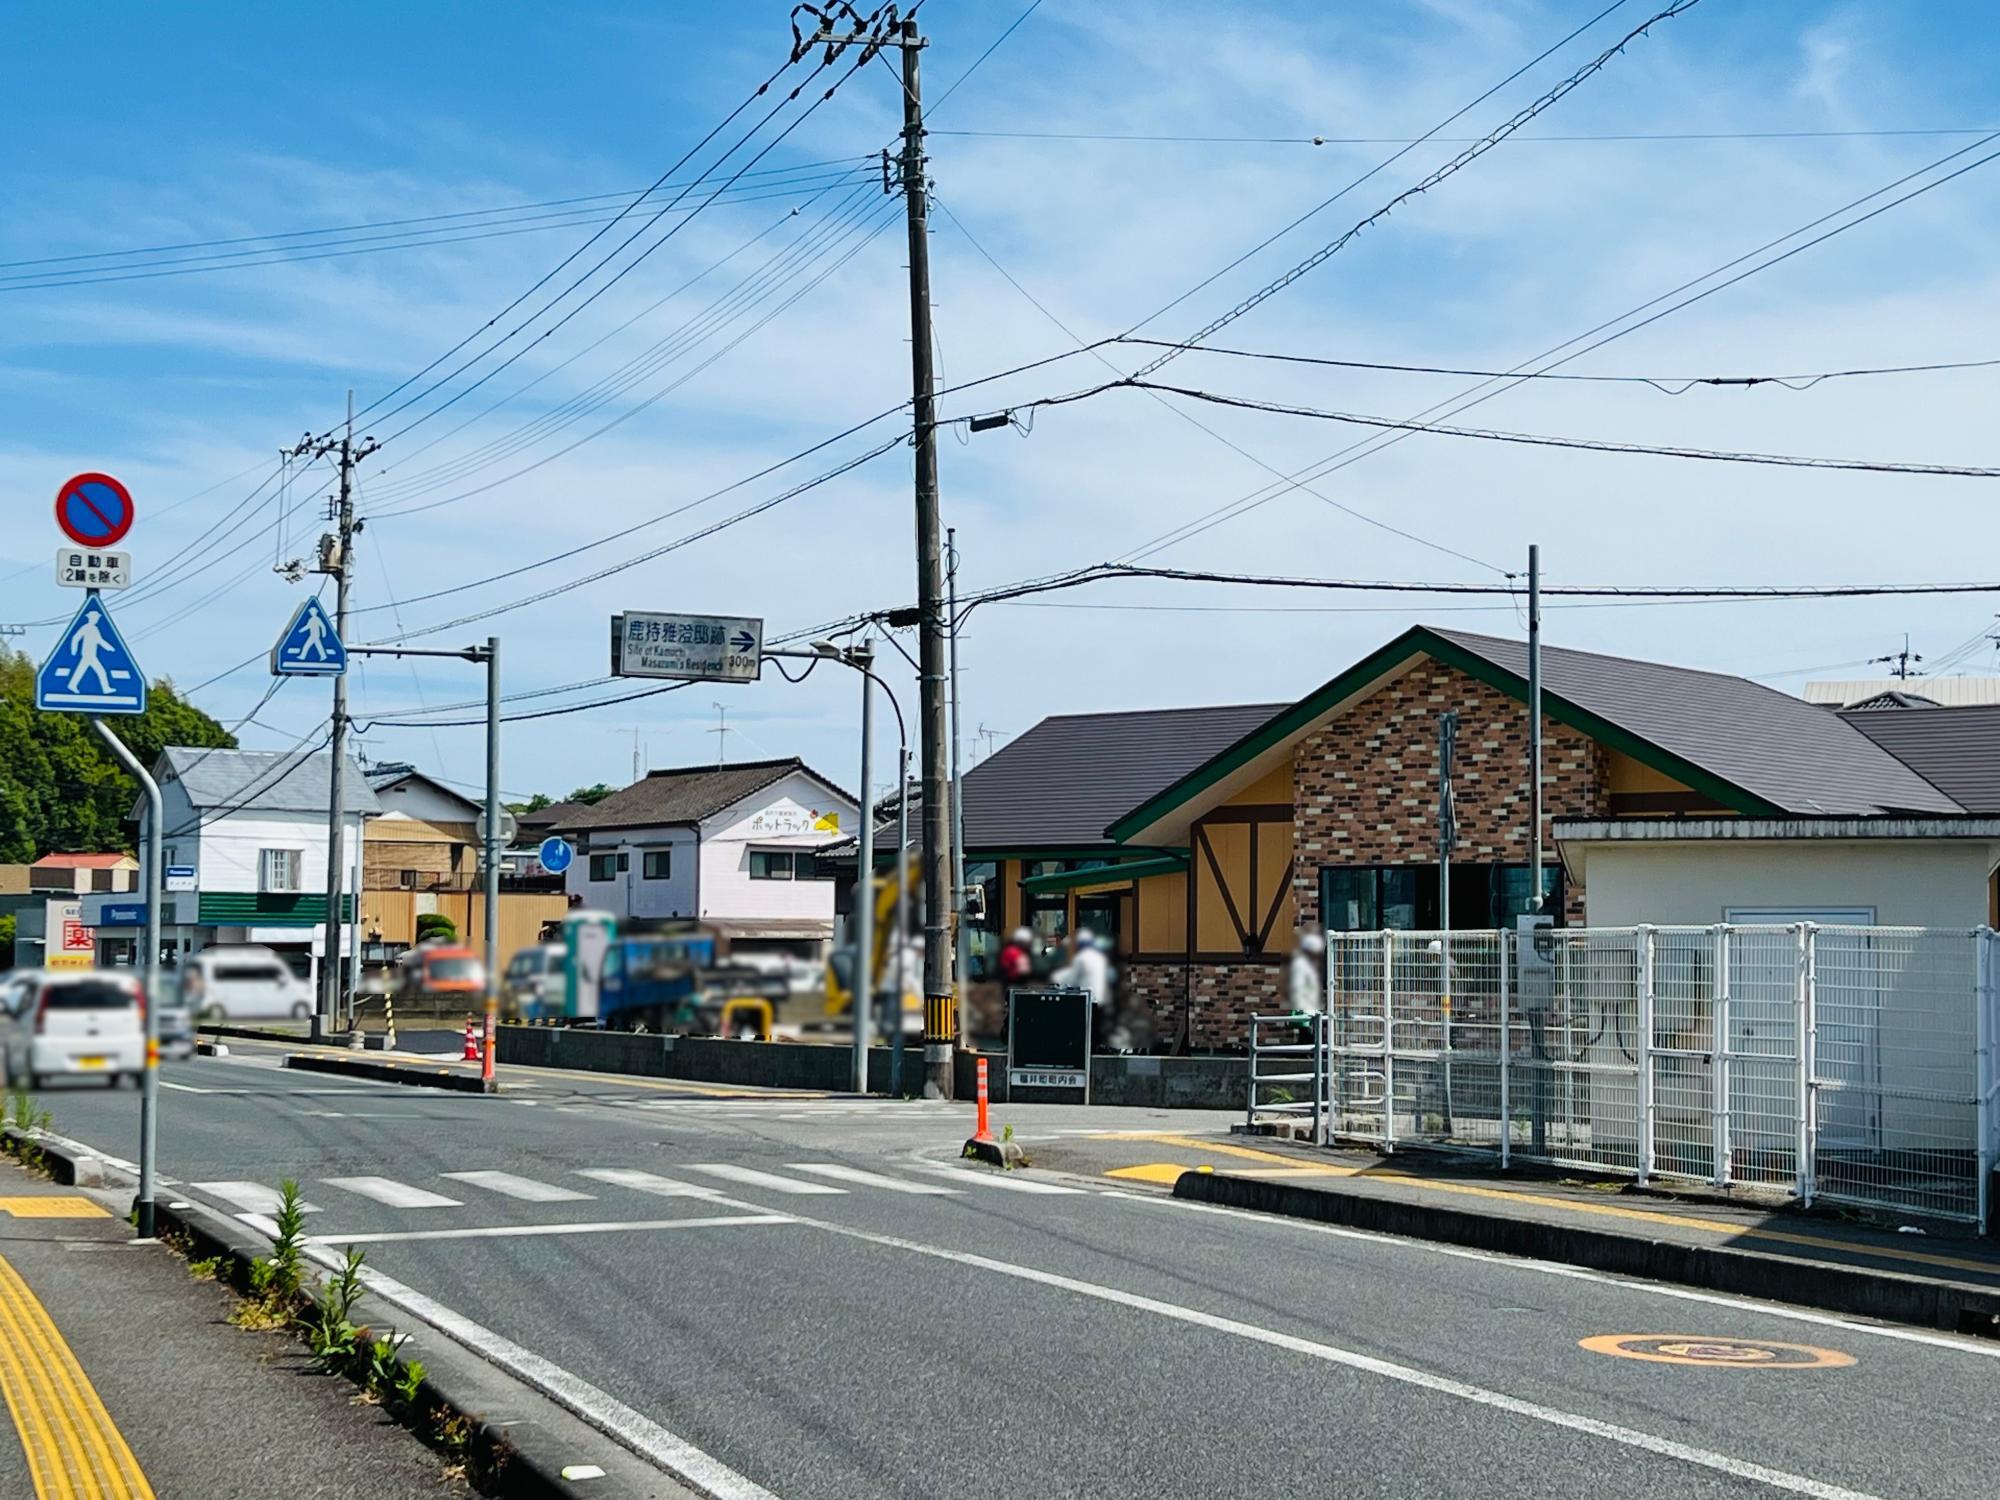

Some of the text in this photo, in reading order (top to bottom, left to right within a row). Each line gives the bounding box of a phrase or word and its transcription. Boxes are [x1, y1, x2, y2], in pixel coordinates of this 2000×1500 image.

[69, 554, 119, 568] 自動車
[628, 620, 726, 645] 鹿持雅澄邸跡
[627, 644, 643, 655] Site
[752, 816, 809, 831] ポットラック
[66, 923, 91, 947] 薬
